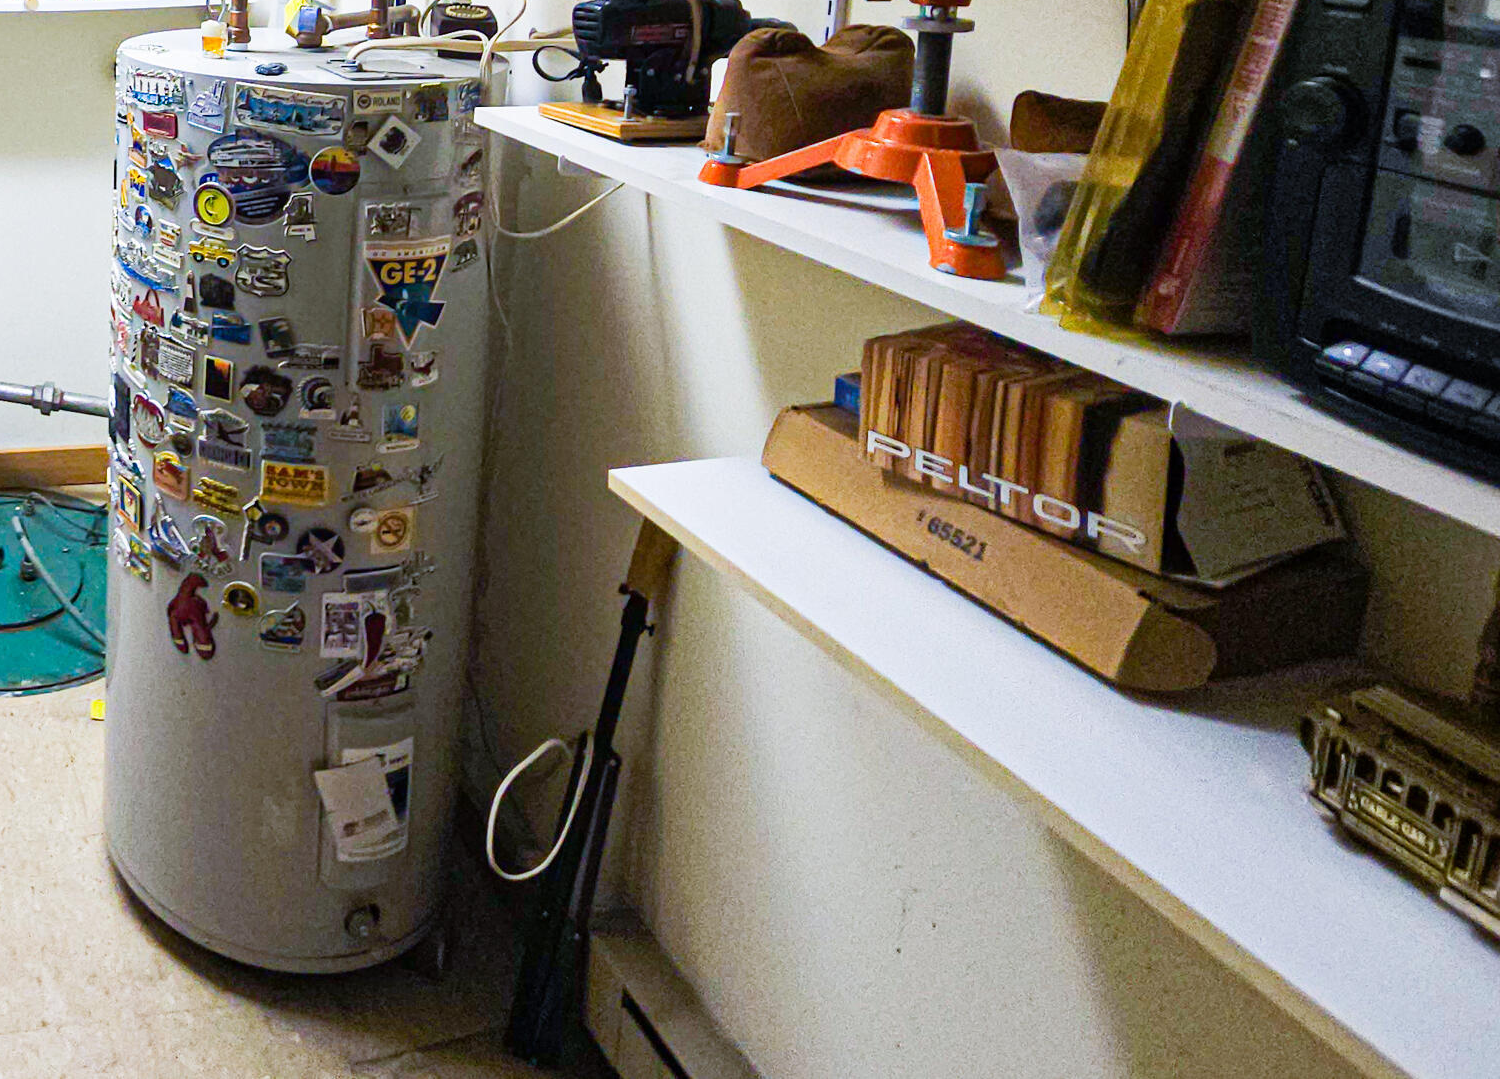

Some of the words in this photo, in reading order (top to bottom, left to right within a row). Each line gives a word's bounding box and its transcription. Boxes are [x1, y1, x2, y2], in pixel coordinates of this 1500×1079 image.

[380, 258, 437, 285] GE-2
[266, 465, 324, 480] SAM'S
[266, 477, 324, 492] TOWN
[866, 429, 1149, 554] PELTOR
[926, 519, 990, 562] 65521
